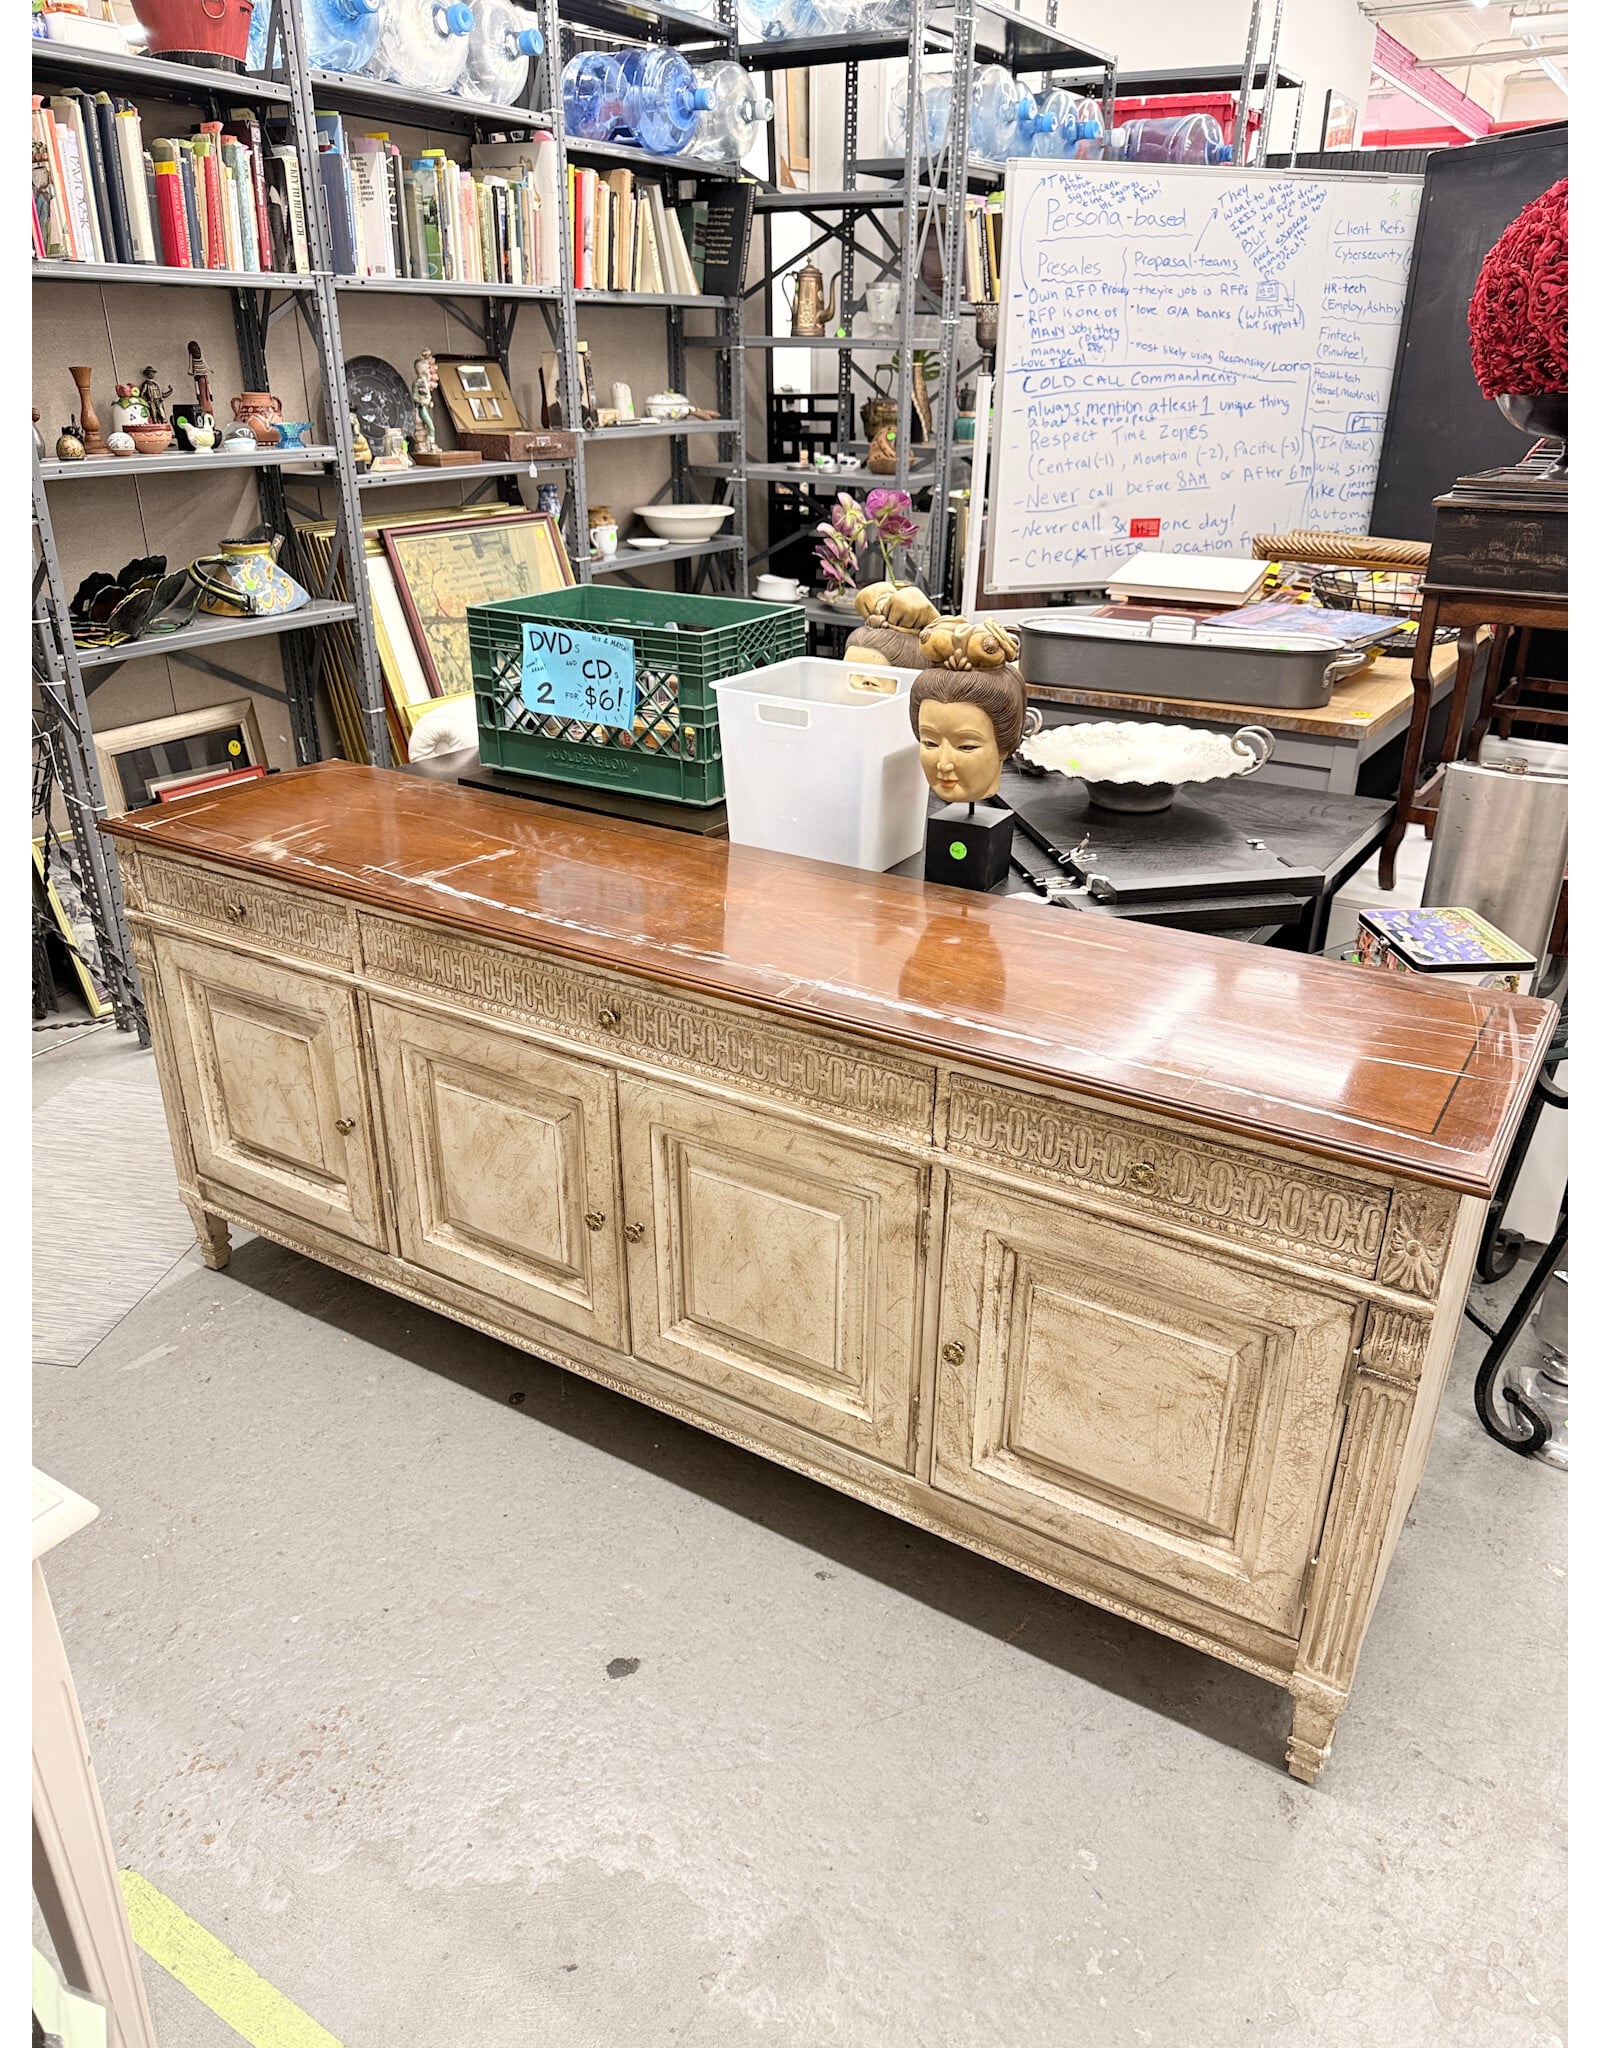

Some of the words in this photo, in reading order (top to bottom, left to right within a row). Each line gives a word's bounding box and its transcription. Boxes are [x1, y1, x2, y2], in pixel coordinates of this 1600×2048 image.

[289, 168, 301, 187] KEY
[1047, 174, 1083, 189] TALK
[293, 189, 302, 201] TO
[1217, 183, 1249, 208] They
[1223, 199, 1251, 220] want
[1253, 192, 1265, 203] to
[1269, 180, 1295, 193] hear
[1260, 195, 1276, 210] will
[1045, 198, 1186, 235] Persona-based
[1261, 212, 1274, 224] to
[1311, 205, 1321, 213] to
[1334, 219, 1371, 236] Client
[1380, 220, 1406, 235] Refs
[1038, 252, 1101, 277] Presales
[1028, 287, 1059, 304] Own
[1065, 283, 1097, 301] RFP
[1177, 286, 1197, 300] job
[1203, 286, 1212, 297] is
[1323, 283, 1367, 294] HR-tech
[1028, 306, 1056, 325] RFP
[1063, 307, 1072, 318] is
[1075, 308, 1100, 318] one
[1104, 307, 1118, 318] of
[1136, 304, 1158, 315] love
[1167, 305, 1190, 318] Q/A
[1196, 307, 1232, 320] banks
[1031, 325, 1066, 340] MANY
[1094, 323, 1120, 341] they
[1319, 326, 1361, 342] Fintech
[1021, 356, 1047, 368] Love
[1031, 347, 1075, 358] manage
[1135, 341, 1159, 352] most
[1163, 345, 1186, 360] likely
[1190, 351, 1213, 364] using
[1022, 374, 1076, 394] COLD
[1082, 372, 1125, 387] CALL
[1027, 401, 1079, 424] Always
[1086, 397, 1143, 416] mention
[1219, 401, 1256, 418] unique
[1260, 396, 1290, 415] thing
[1075, 415, 1097, 426] the
[1029, 429, 1097, 451] Respect
[1112, 426, 1147, 446] Time
[1159, 424, 1209, 440] Zones
[1133, 451, 1187, 471] Mountain
[1233, 441, 1277, 459] Pacific
[1315, 463, 1340, 477] with
[1025, 487, 1079, 509] Never
[1088, 482, 1114, 500] call
[1126, 480, 1172, 496] before
[1176, 472, 1208, 488] 8AM
[1220, 471, 1232, 481] or
[1243, 467, 1283, 483] After
[1310, 484, 1336, 503] like
[1022, 517, 1068, 539] Never
[1072, 512, 1102, 531] call
[1111, 516, 1128, 534] 3x
[1161, 518, 1192, 531] one
[1199, 504, 1237, 536] day!
[1025, 546, 1088, 568] Check
[536, 681, 555, 705] 2
[565, 691, 579, 700] FOR
[585, 685, 624, 712] $6!
